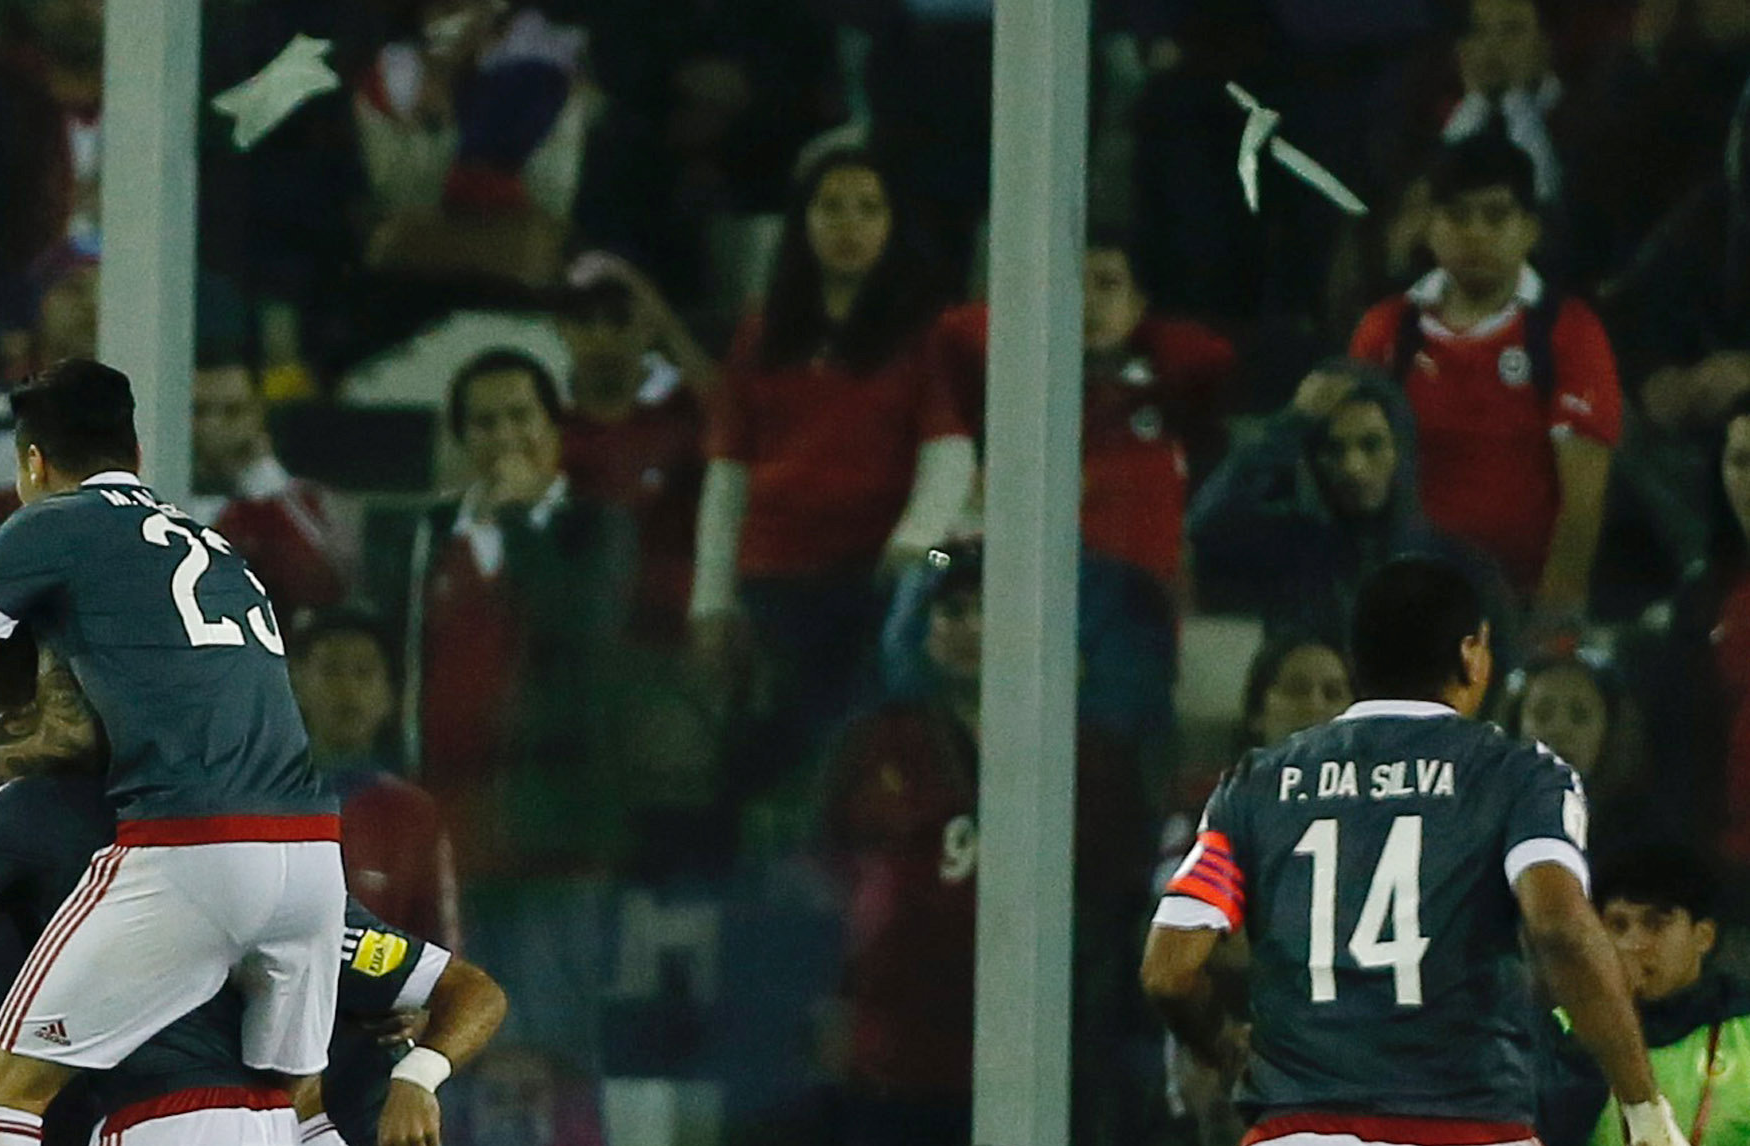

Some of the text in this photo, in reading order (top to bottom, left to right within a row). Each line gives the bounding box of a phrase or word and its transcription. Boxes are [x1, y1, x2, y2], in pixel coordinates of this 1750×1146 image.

[1279, 758, 1455, 801] P. DA SILVA
[1293, 815, 1431, 1005] 14
